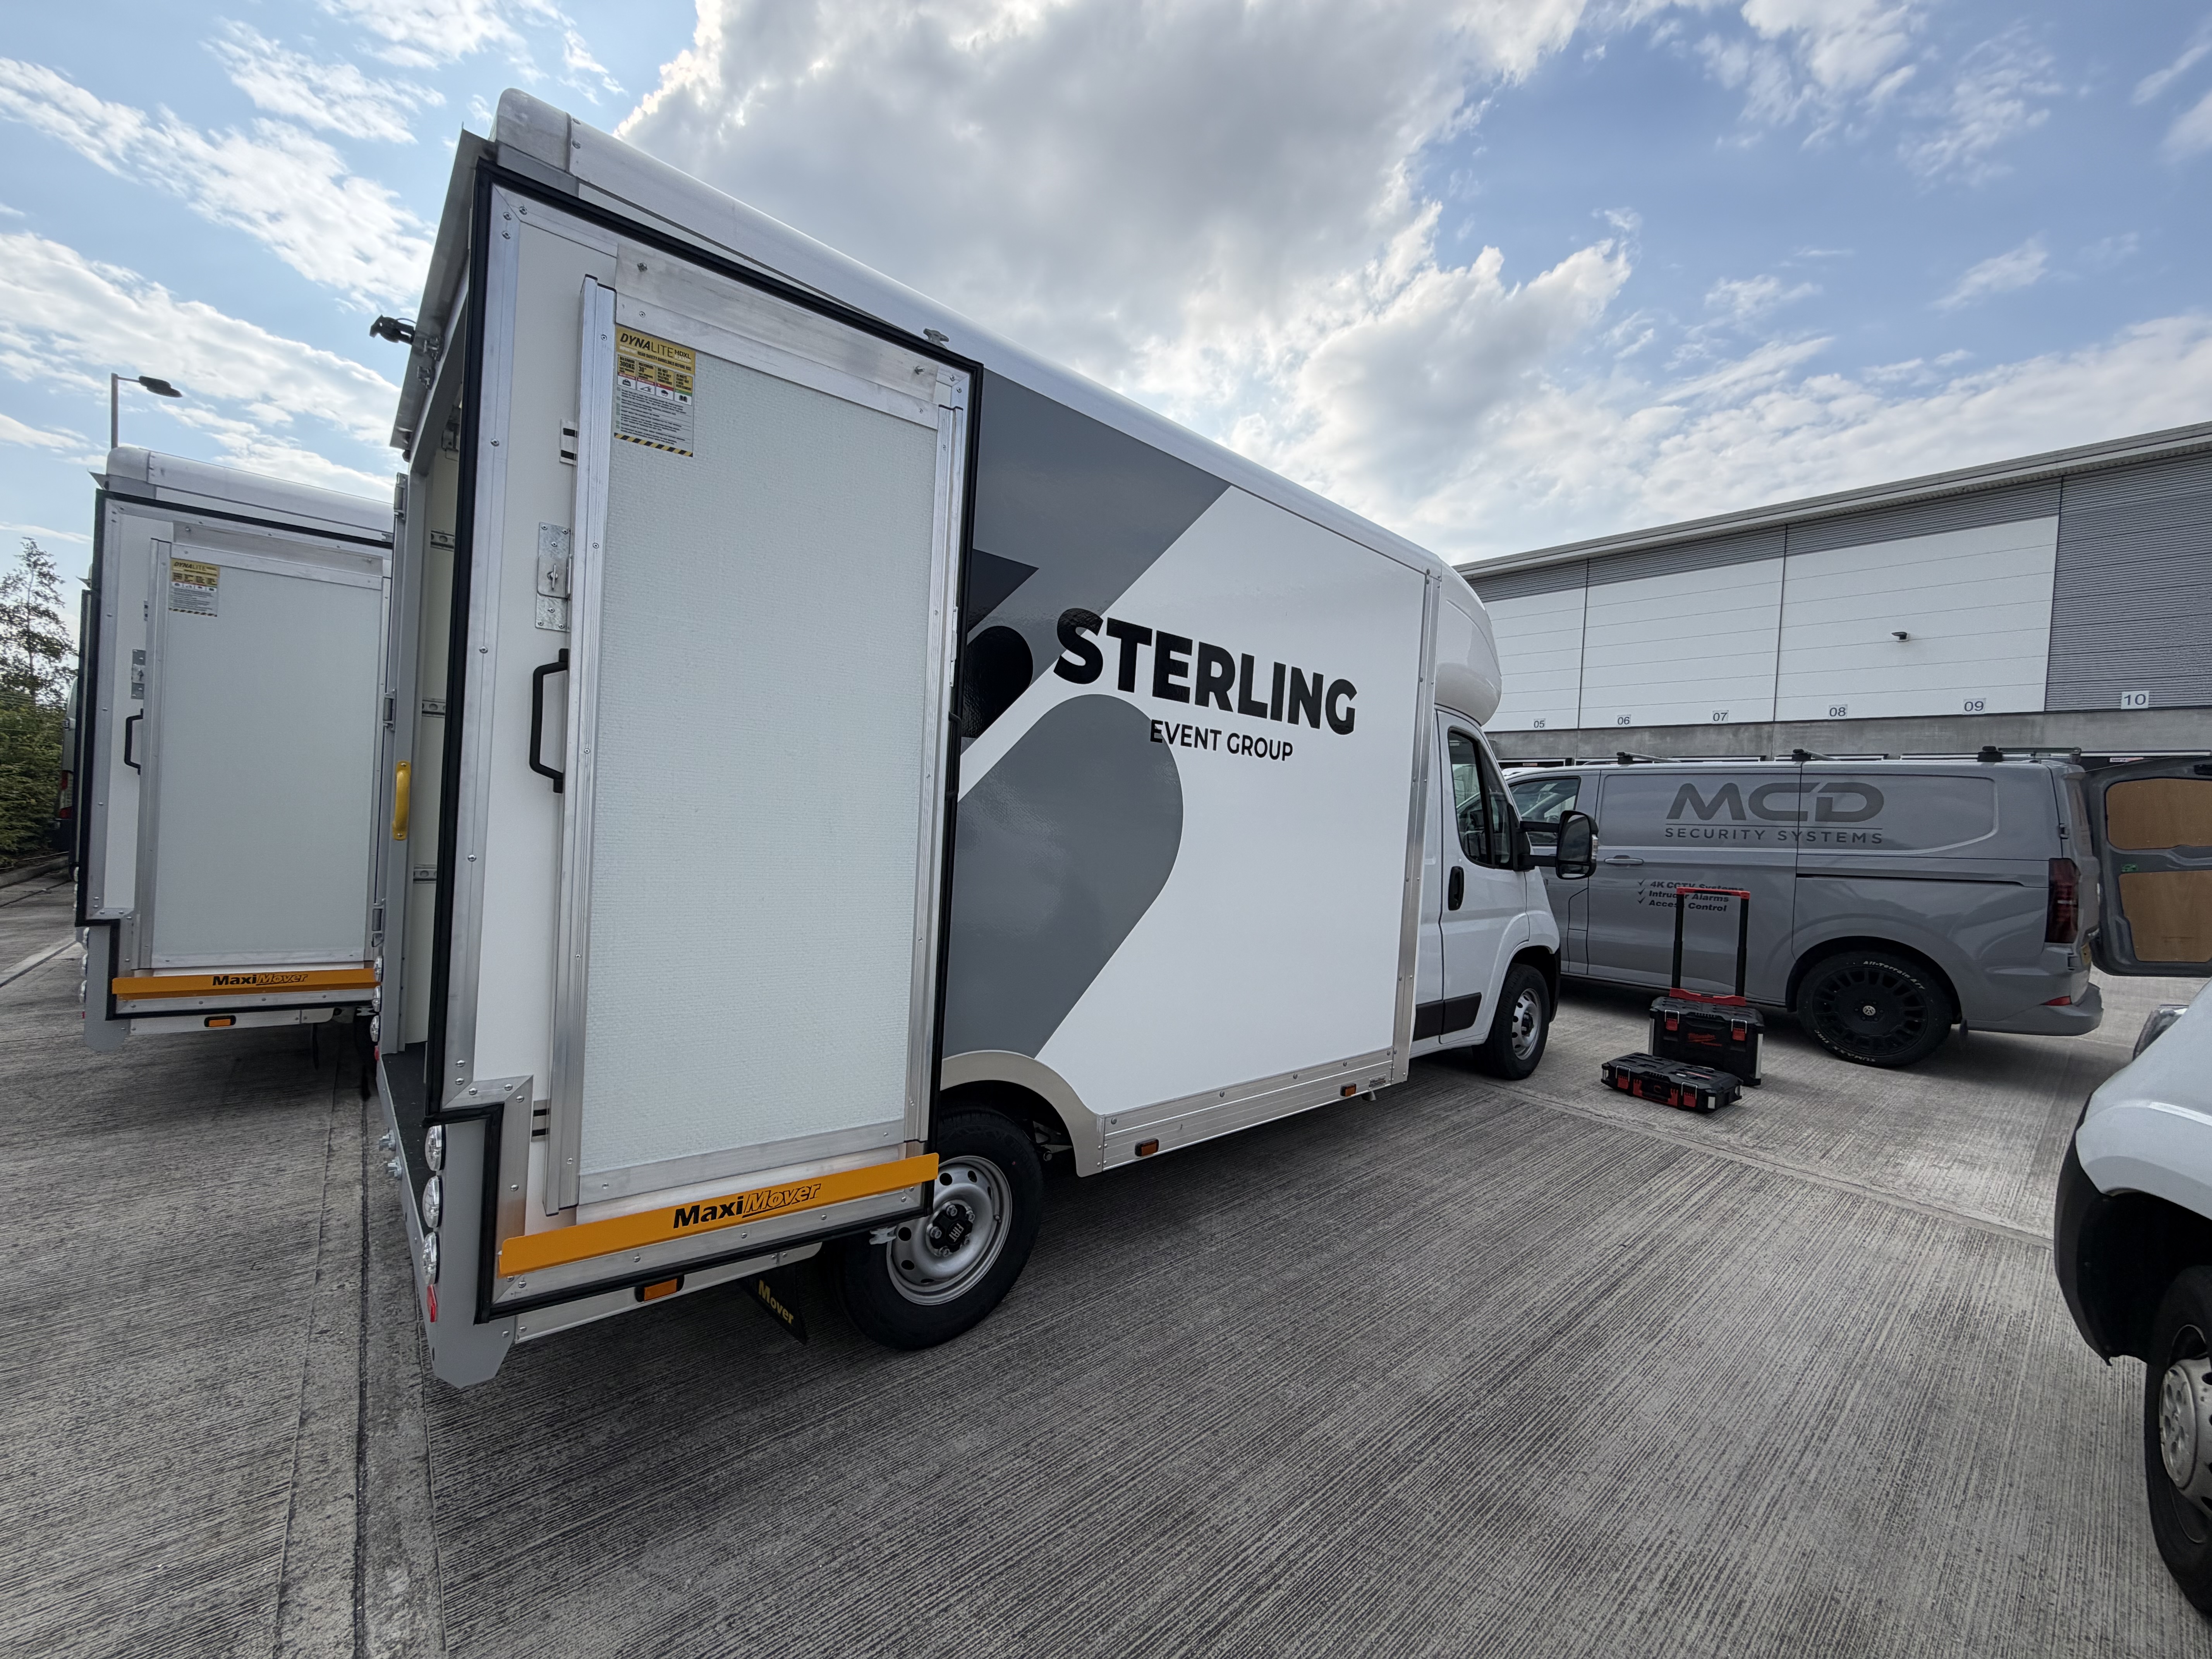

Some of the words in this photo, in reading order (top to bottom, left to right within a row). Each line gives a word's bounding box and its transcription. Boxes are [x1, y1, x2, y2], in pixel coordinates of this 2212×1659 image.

[620, 333, 673, 358] DYNALITE
[675, 350, 691, 359] HDXL
[174, 562, 206, 571] DYNALITE
[1053, 608, 1357, 735] STERLING
[1964, 701, 1984, 711] 09
[2123, 694, 2146, 706] 10
[1713, 713, 1728, 721] 07
[1829, 707, 1846, 716] 08
[1534, 720, 1545, 728] 05
[1618, 716, 1630, 725] 06
[1150, 719, 1222, 751] EVENT
[1227, 733, 1293, 761] GROUP
[1666, 782, 1884, 822] MCD
[1665, 828, 1765, 840] SECURITY
[1778, 830, 1882, 844] SYSTEMS
[1649, 890, 1690, 899] Intrur
[1692, 893, 1729, 902] Alarms
[1688, 902, 1727, 912] Control
[213, 974, 308, 986] MaxiMover
[673, 1183, 821, 1229] MaxiMover
[949, 1223, 964, 1242] FIAT
[758, 1279, 794, 1324] Mover
